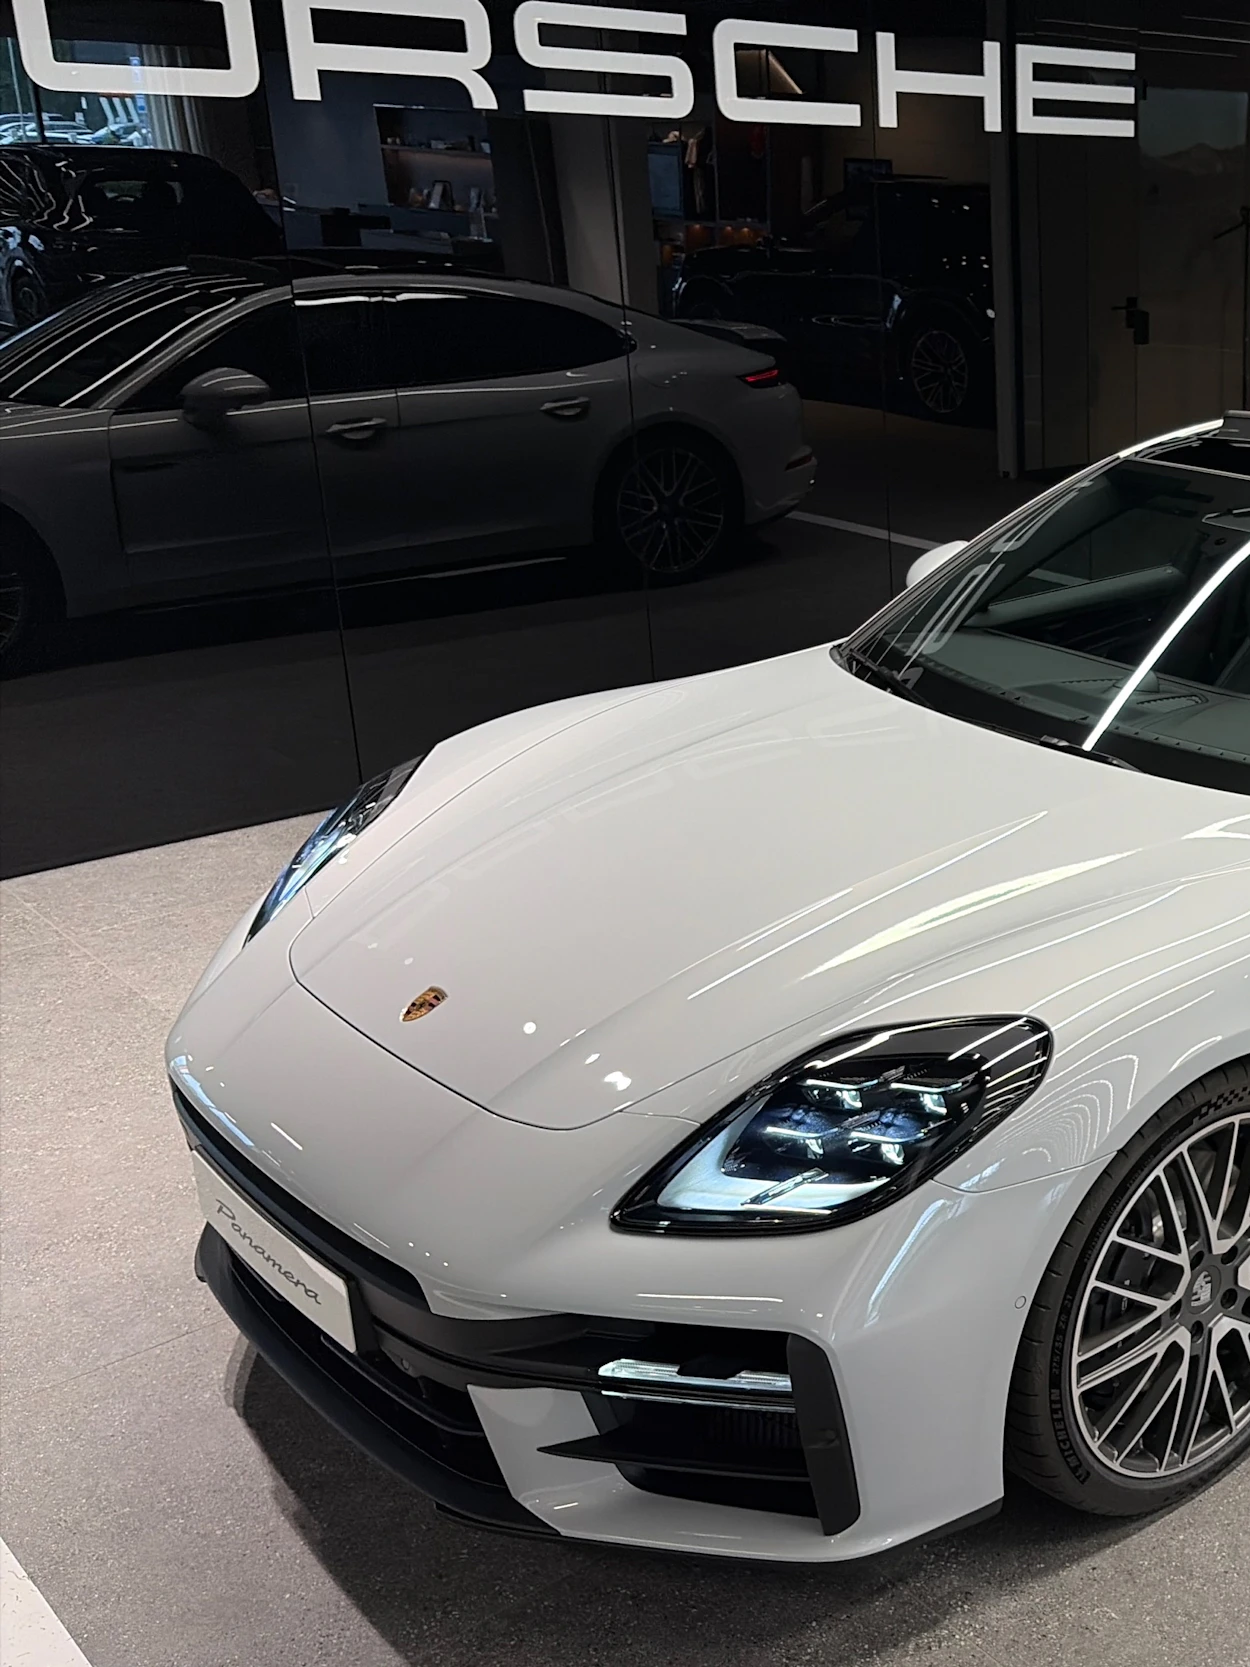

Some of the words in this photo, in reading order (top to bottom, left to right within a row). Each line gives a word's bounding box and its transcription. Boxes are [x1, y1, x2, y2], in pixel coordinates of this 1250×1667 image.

[15, 0, 1135, 137] ORSCHE
[215, 1199, 321, 1305] Panamera
[1050, 1388, 1081, 1467] MICHELIN
